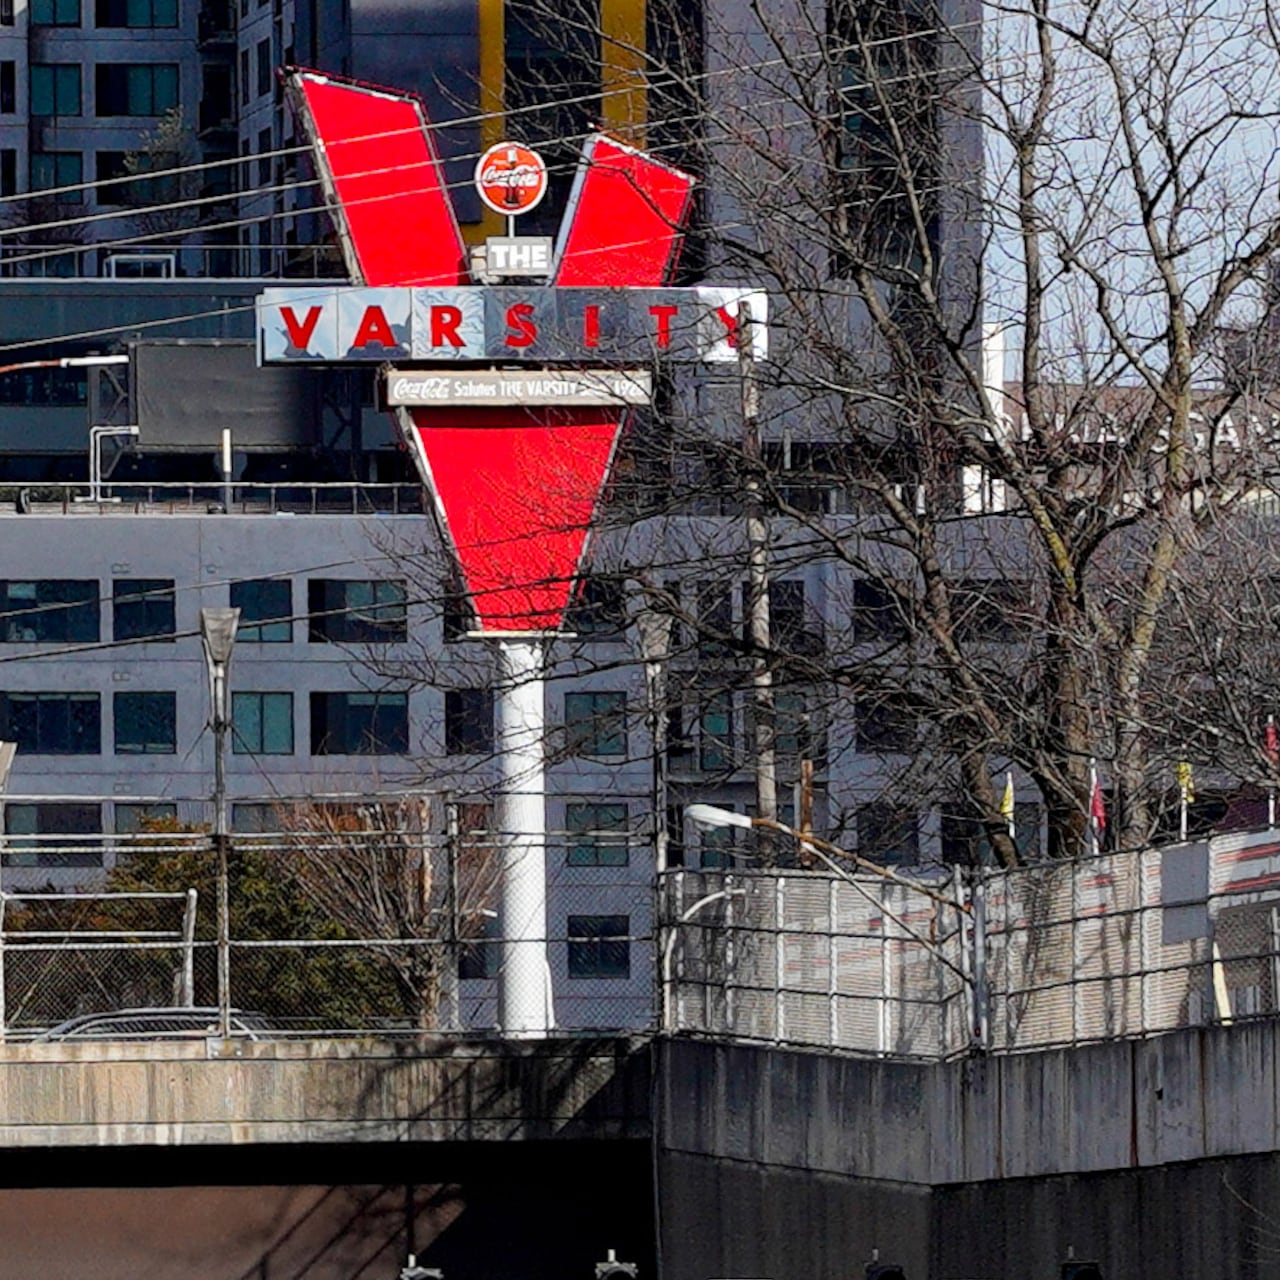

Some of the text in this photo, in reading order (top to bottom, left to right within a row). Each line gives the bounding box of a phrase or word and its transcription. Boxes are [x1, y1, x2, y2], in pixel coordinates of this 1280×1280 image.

[490, 244, 547, 269] THE
[279, 304, 740, 349] VARSITY
[454, 381, 496, 397] Salutes
